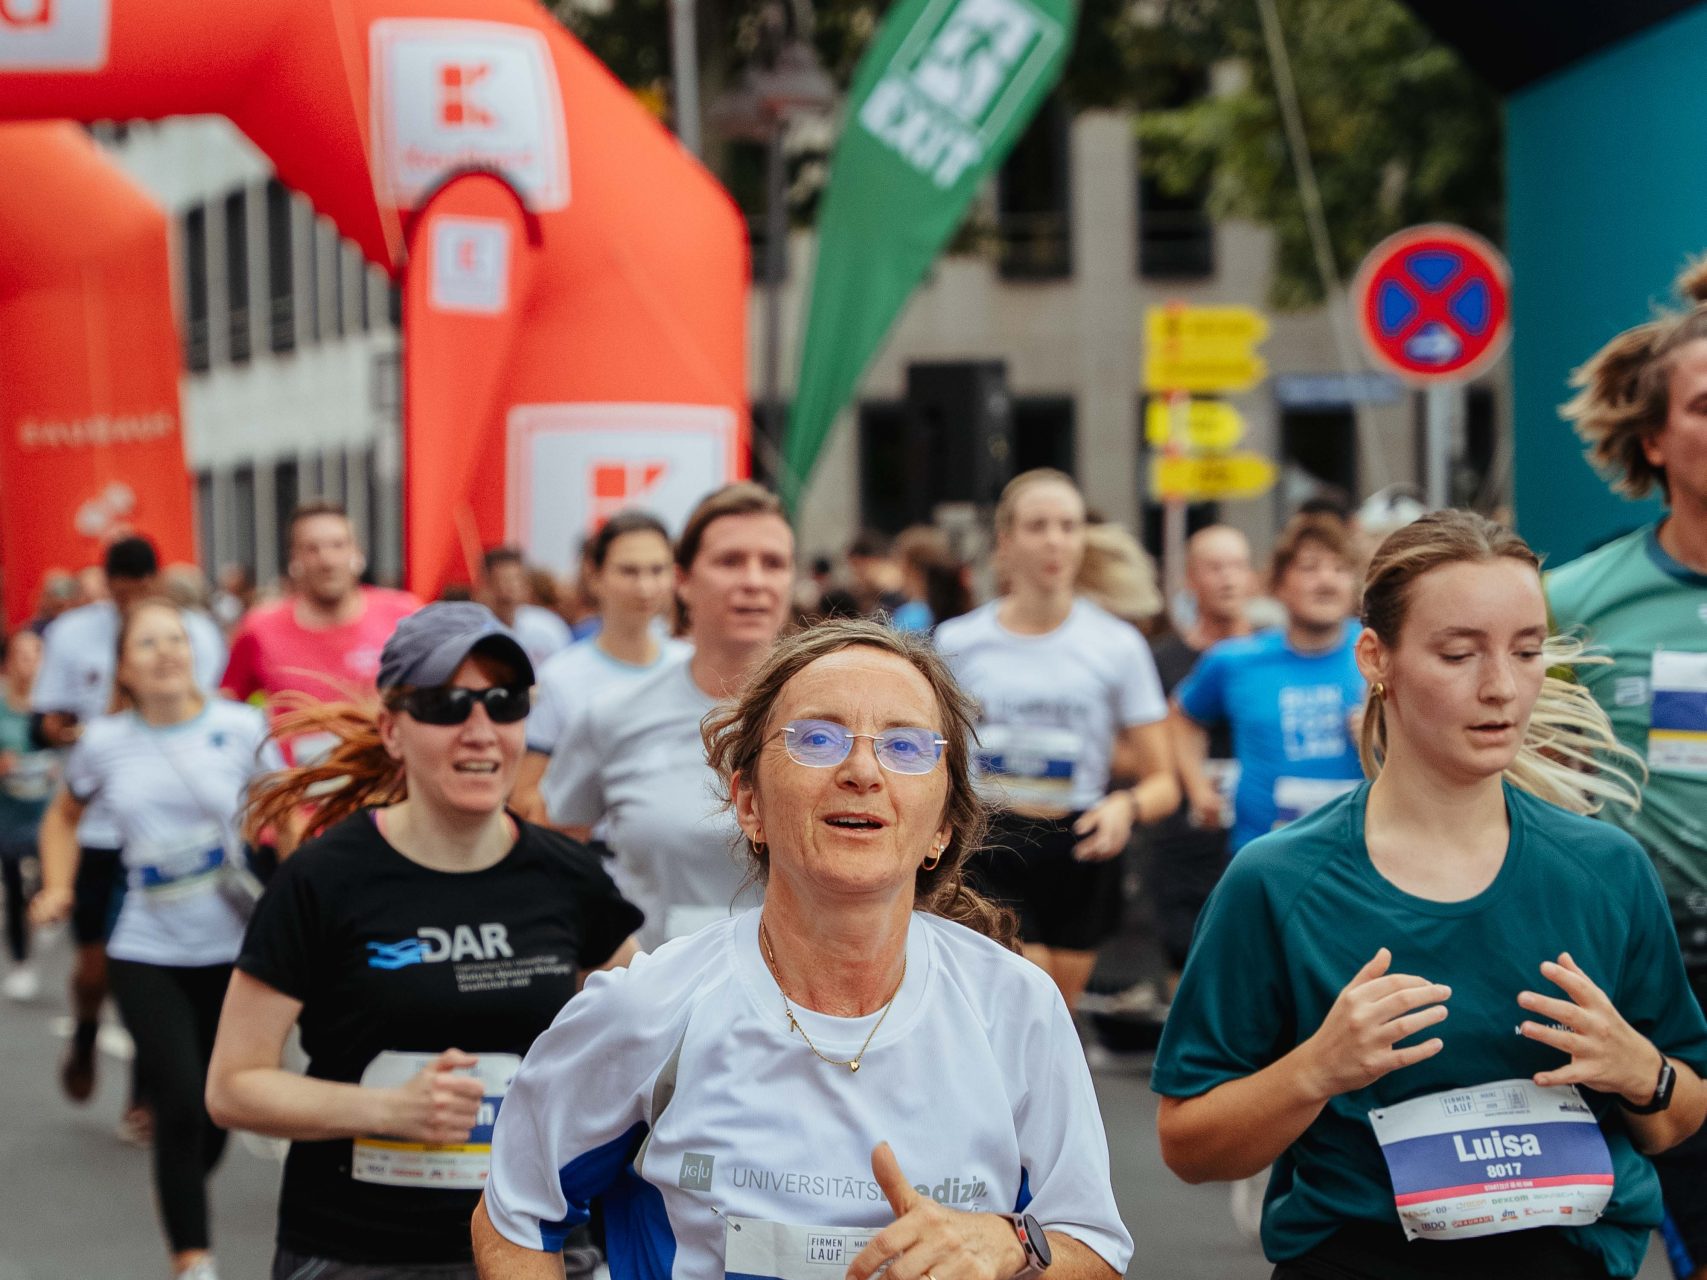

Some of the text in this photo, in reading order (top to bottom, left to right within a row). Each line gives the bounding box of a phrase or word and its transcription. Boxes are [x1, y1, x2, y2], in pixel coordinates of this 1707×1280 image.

[417, 922, 514, 963] DAR
[1446, 1102, 1472, 1115] LAUF
[1453, 1130, 1541, 1163] Luisa
[1486, 1162, 1522, 1179] 8017
[811, 1237, 842, 1247] FIRMEN
[810, 1248, 842, 1261] LAUF
